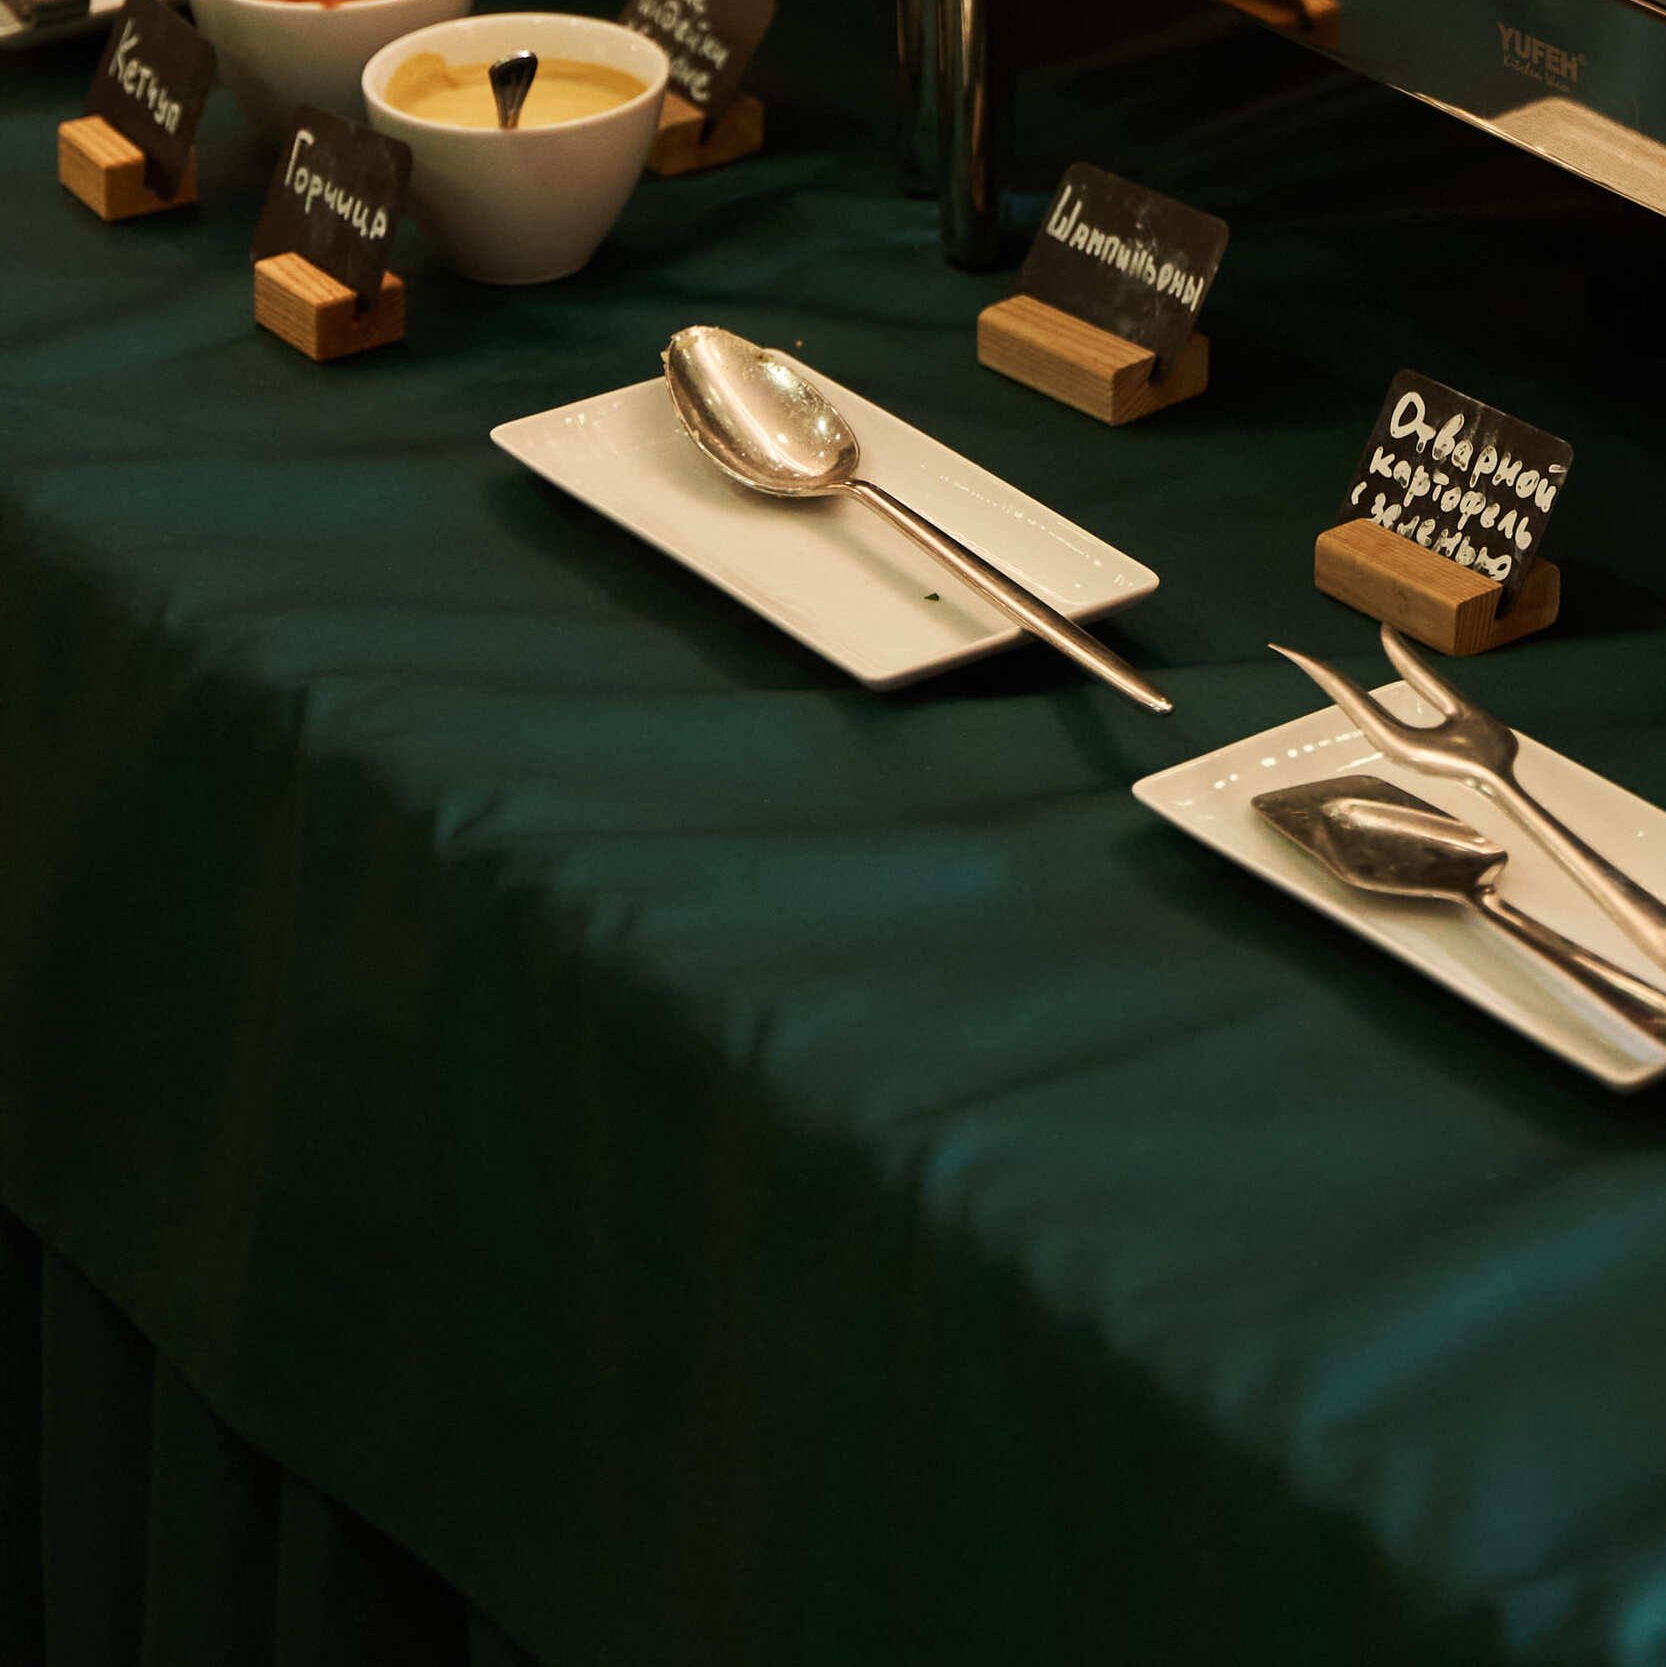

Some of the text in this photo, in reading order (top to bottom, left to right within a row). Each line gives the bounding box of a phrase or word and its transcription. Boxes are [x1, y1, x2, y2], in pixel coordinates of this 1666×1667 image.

[108, 19, 182, 134] Кетчуп
[285, 129, 388, 240] Горчица
[1369, 446, 1533, 551] картофель
[1390, 391, 1567, 513] Отварной
